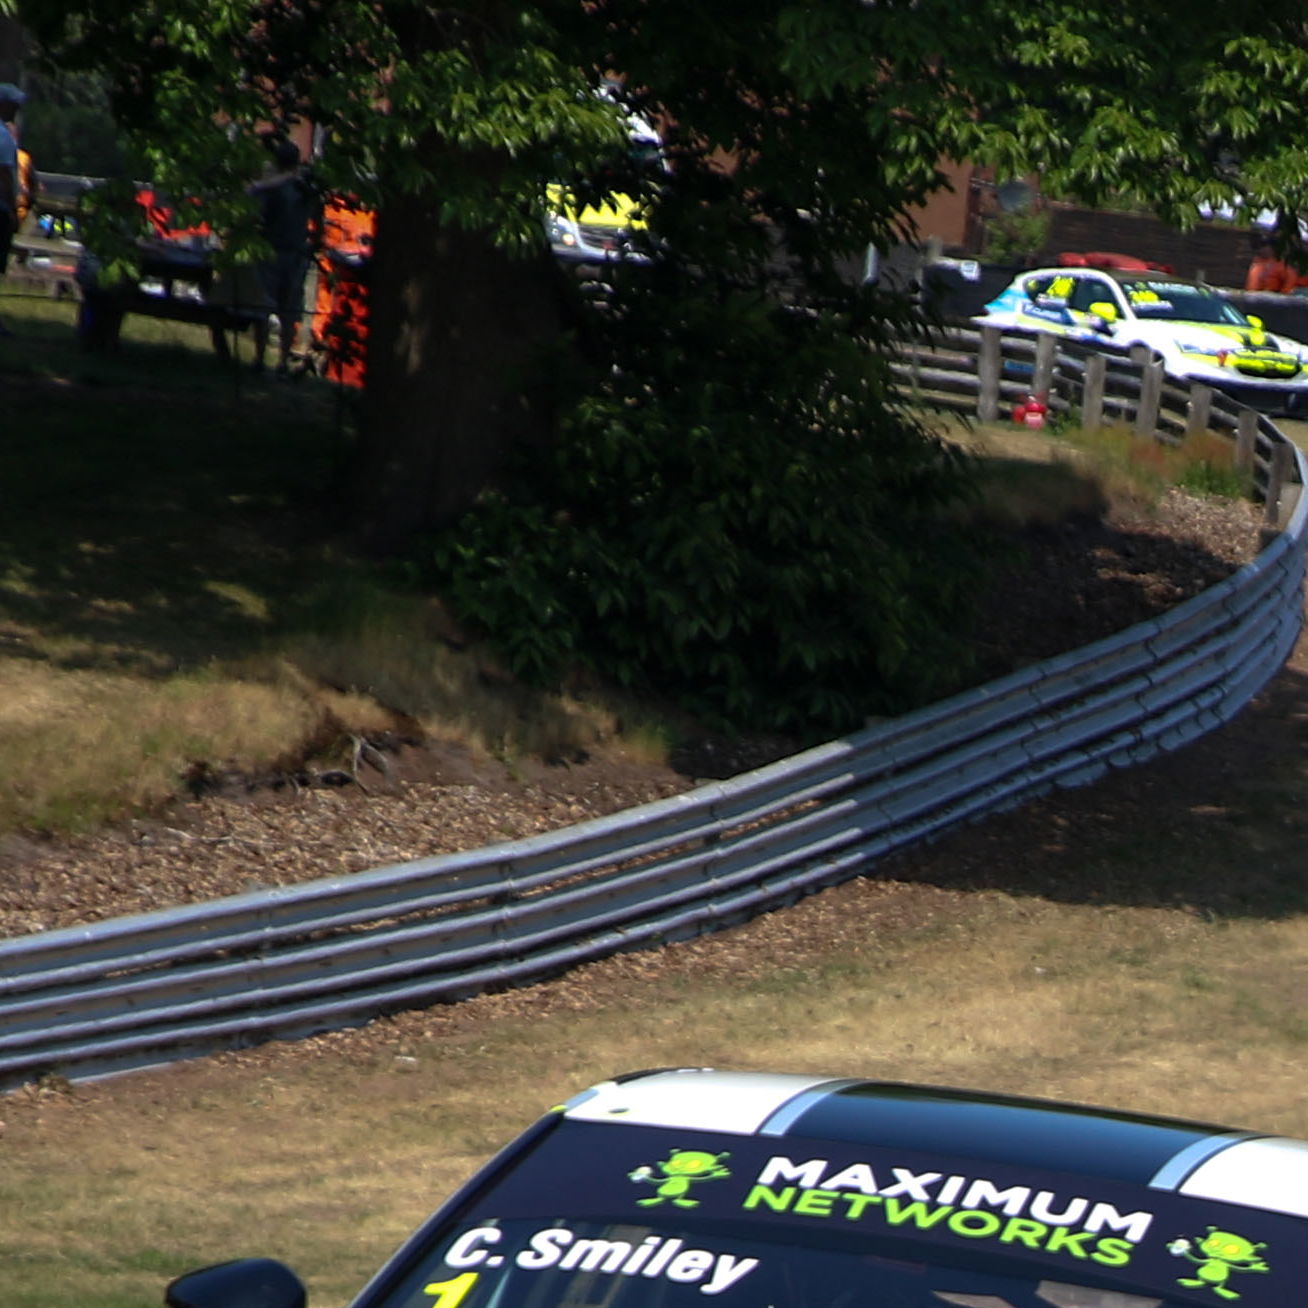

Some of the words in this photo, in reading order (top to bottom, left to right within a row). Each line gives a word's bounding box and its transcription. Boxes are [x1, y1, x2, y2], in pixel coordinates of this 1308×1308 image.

[742, 1185, 1134, 1268] NETWORKS
[757, 1156, 1153, 1243] MAXIMUM
[444, 1226, 502, 1268] C.
[515, 1228, 759, 1295] Smiley
